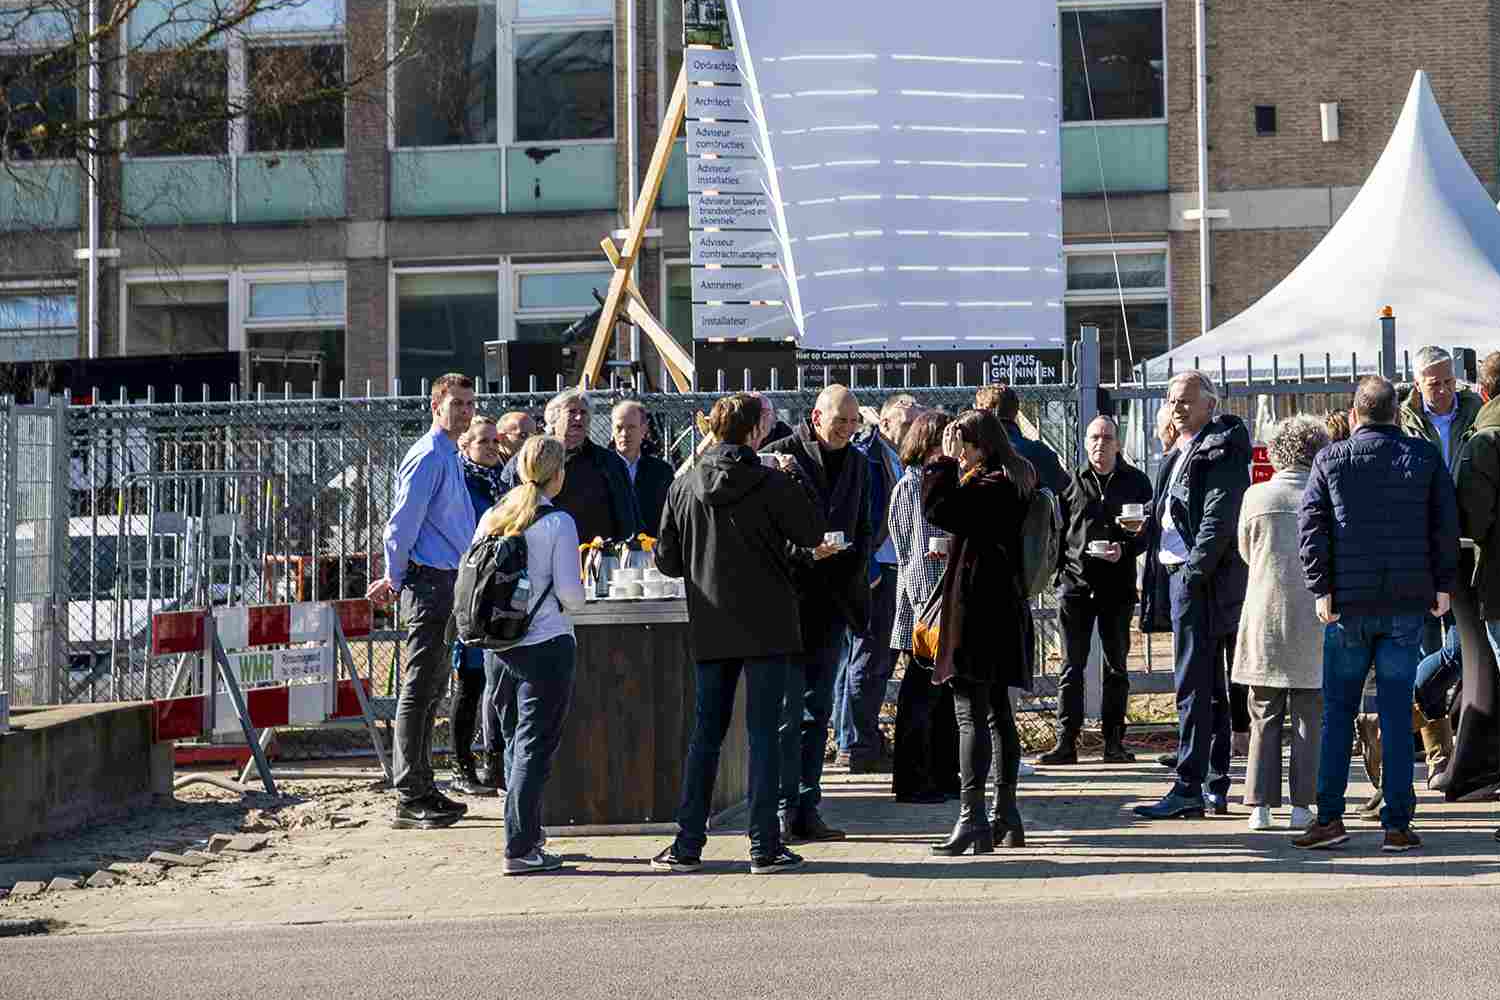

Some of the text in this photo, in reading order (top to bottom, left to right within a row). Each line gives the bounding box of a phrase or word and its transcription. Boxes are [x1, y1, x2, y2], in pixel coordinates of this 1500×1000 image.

[821, 350, 848, 361] Campus
[849, 350, 885, 361] Groningen
[991, 354, 1036, 366] CAMPUS
